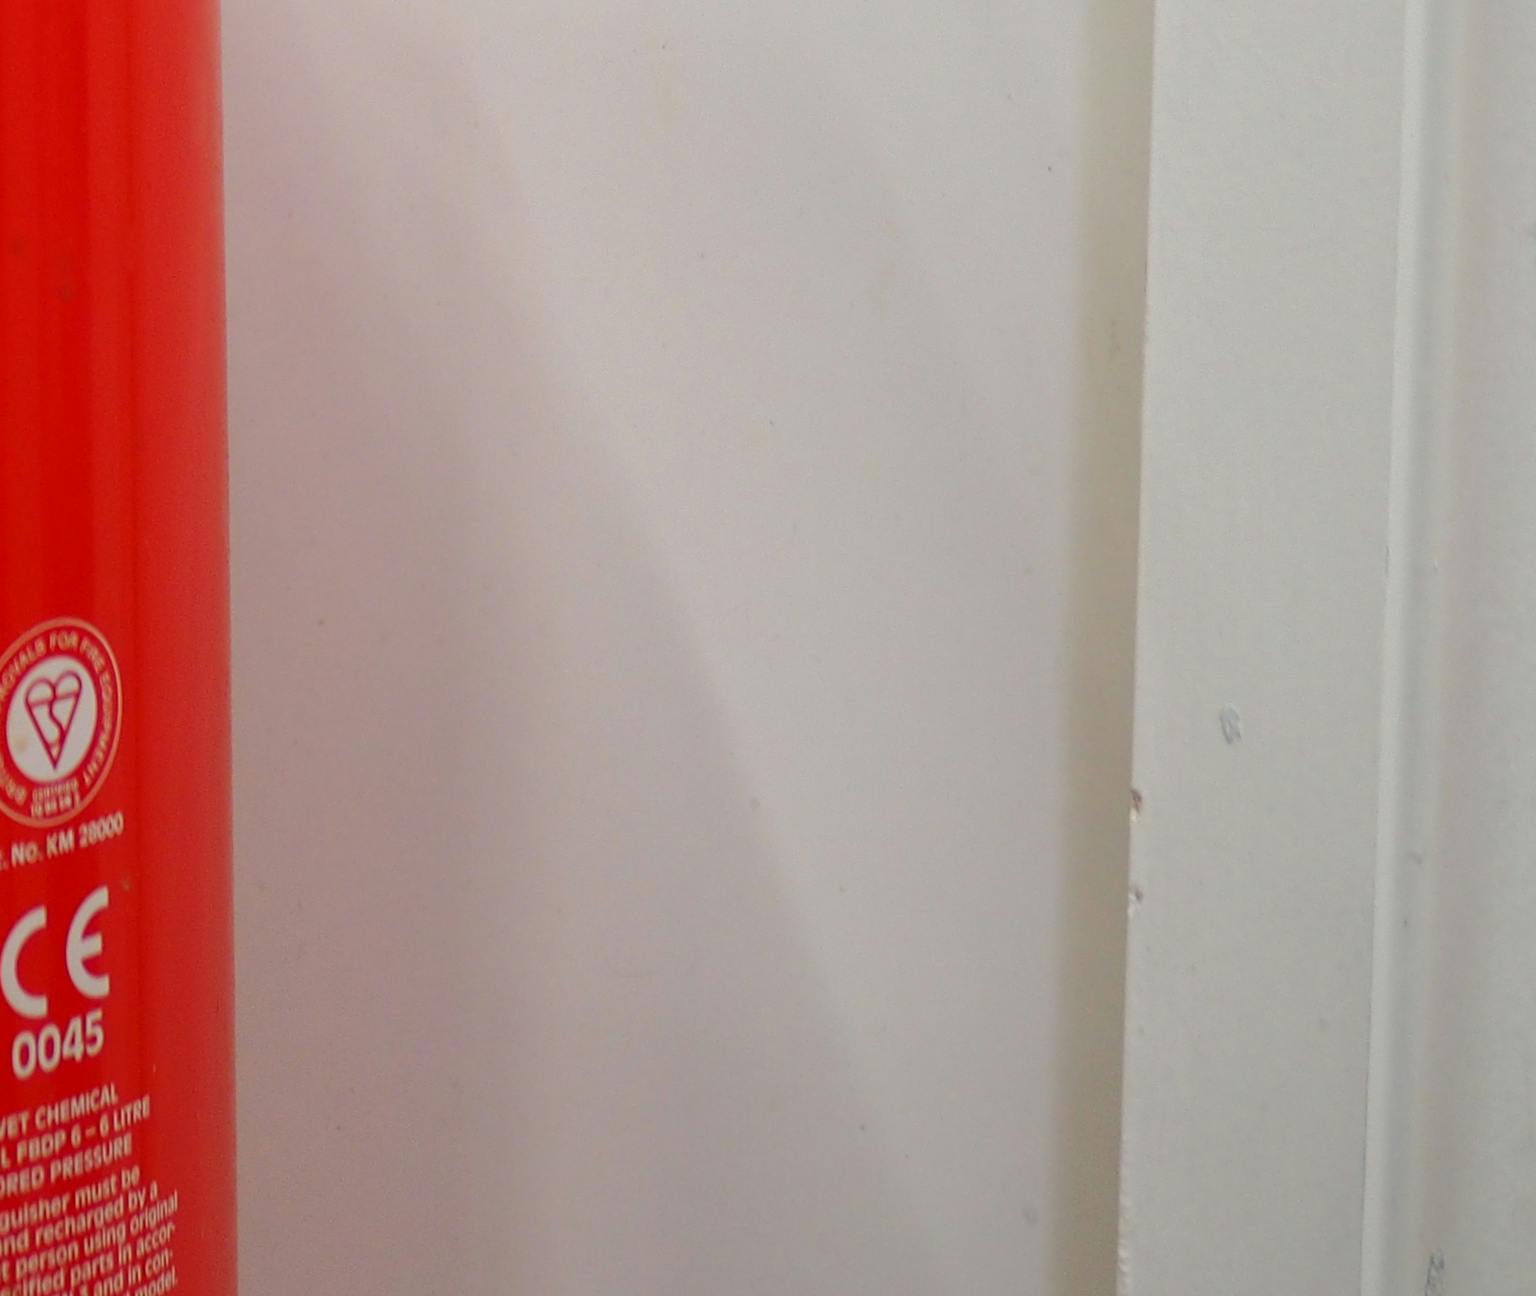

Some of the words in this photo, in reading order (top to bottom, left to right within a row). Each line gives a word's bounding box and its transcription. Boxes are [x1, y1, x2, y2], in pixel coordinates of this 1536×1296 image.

[46, 827, 75, 860] KM
[78, 810, 125, 849] 28000
[0, 885, 110, 1019] CE
[11, 1009, 105, 1081] 0045
[34, 1082, 119, 1131] CHEMICAL
[70, 1123, 82, 1148] 6
[99, 1112, 110, 1138] 6
[113, 1093, 151, 1132] LITRE
[50, 1132, 133, 1184] PRESSURE
[75, 1172, 117, 1210] must
[121, 1163, 141, 1191] be
[14, 1240, 79, 1284] person
[83, 1219, 127, 1260] using
[129, 1187, 179, 1237] original
[34, 1193, 125, 1249] recharged
[128, 1184, 147, 1213] by
[149, 1179, 159, 1203] a
[70, 1251, 115, 1287] parts
[117, 1242, 133, 1265] in
